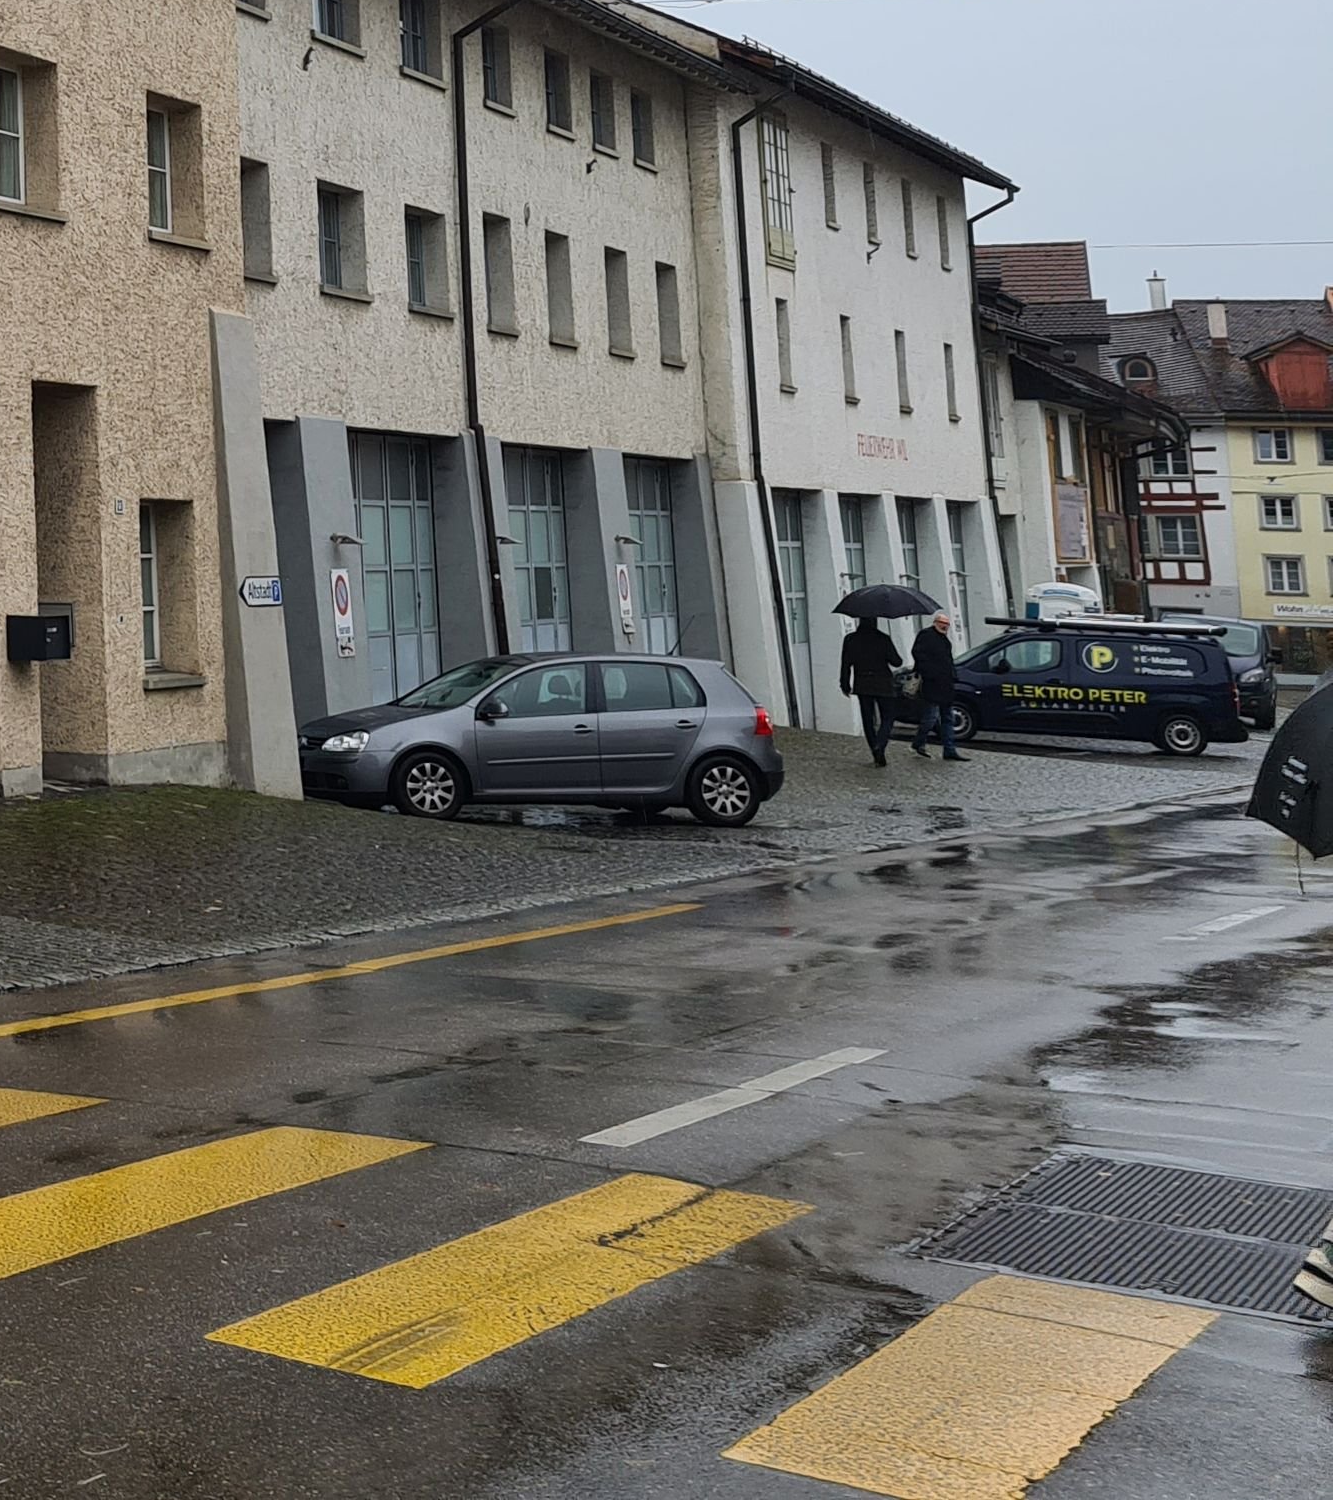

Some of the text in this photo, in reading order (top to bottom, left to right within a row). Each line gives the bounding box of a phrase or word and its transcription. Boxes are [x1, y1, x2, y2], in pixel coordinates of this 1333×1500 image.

[248, 581, 272, 599] Altstadt
[1001, 683, 1147, 704] ELEKTRO PETER
